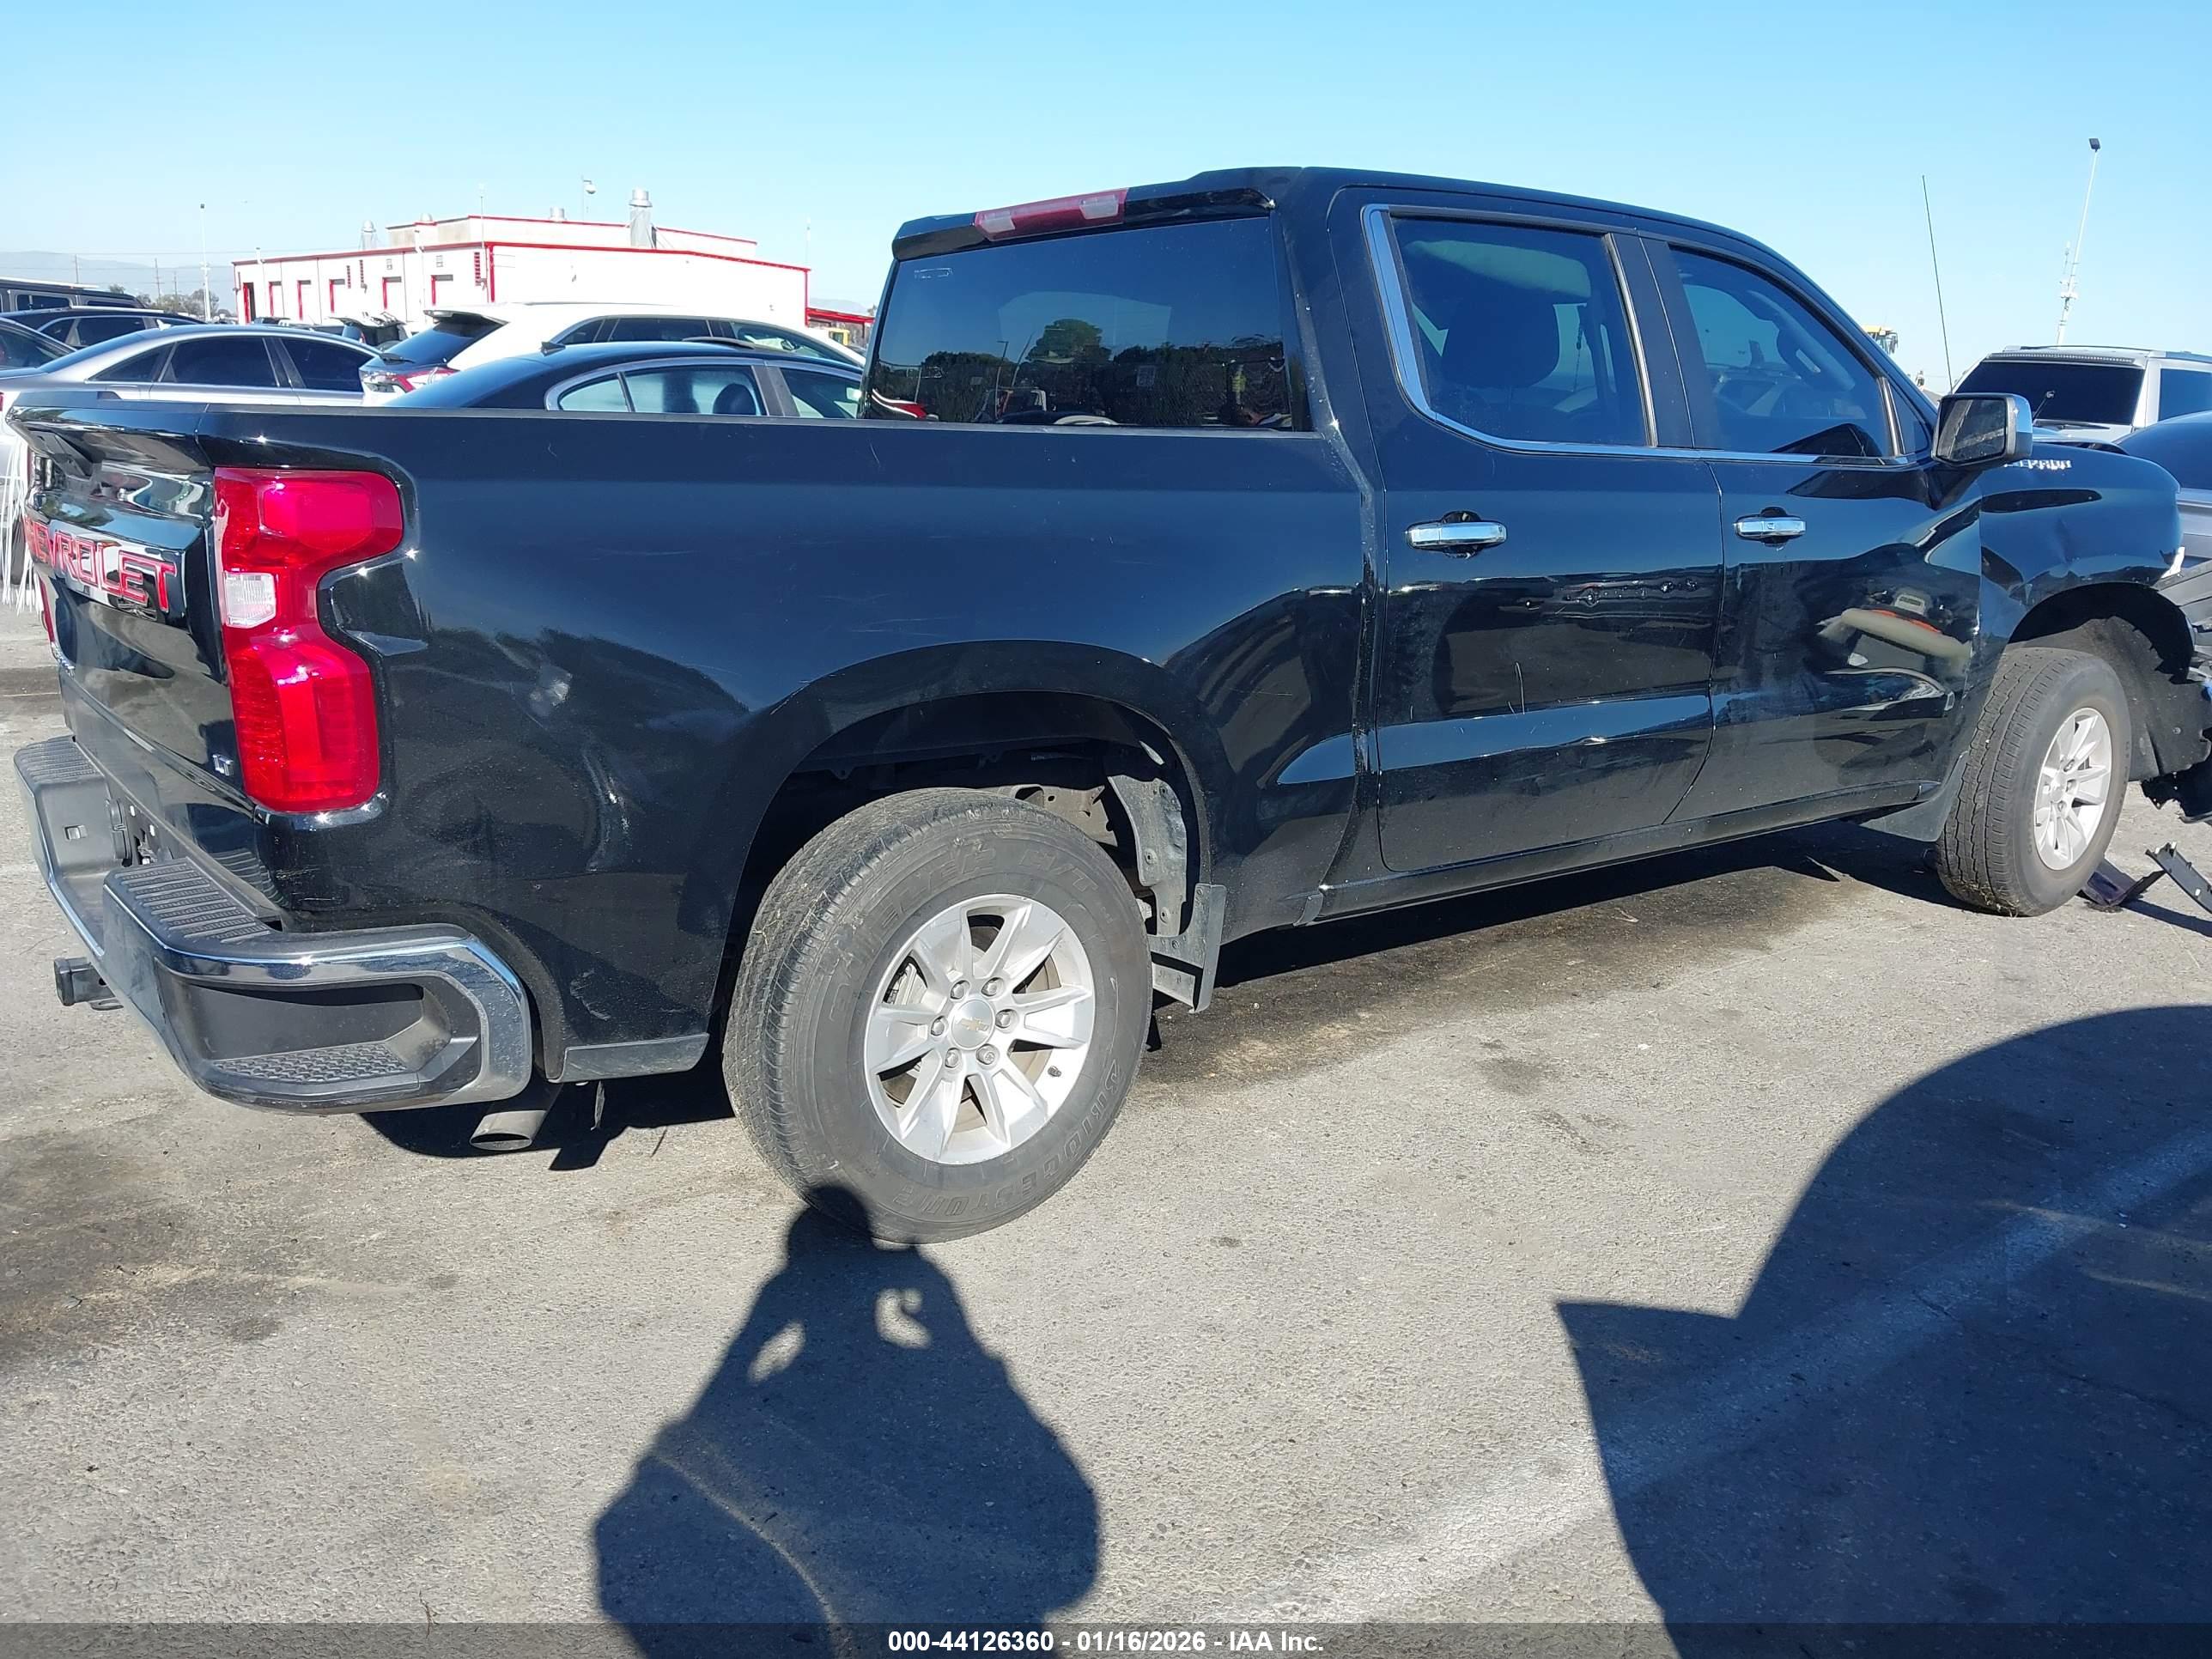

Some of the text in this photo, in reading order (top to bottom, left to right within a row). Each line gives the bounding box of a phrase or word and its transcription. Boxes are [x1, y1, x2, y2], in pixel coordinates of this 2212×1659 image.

[25, 515, 178, 612] HEVROLET
[212, 754, 234, 776] LT
[893, 1060, 1121, 1217] BRIDGESTONE
